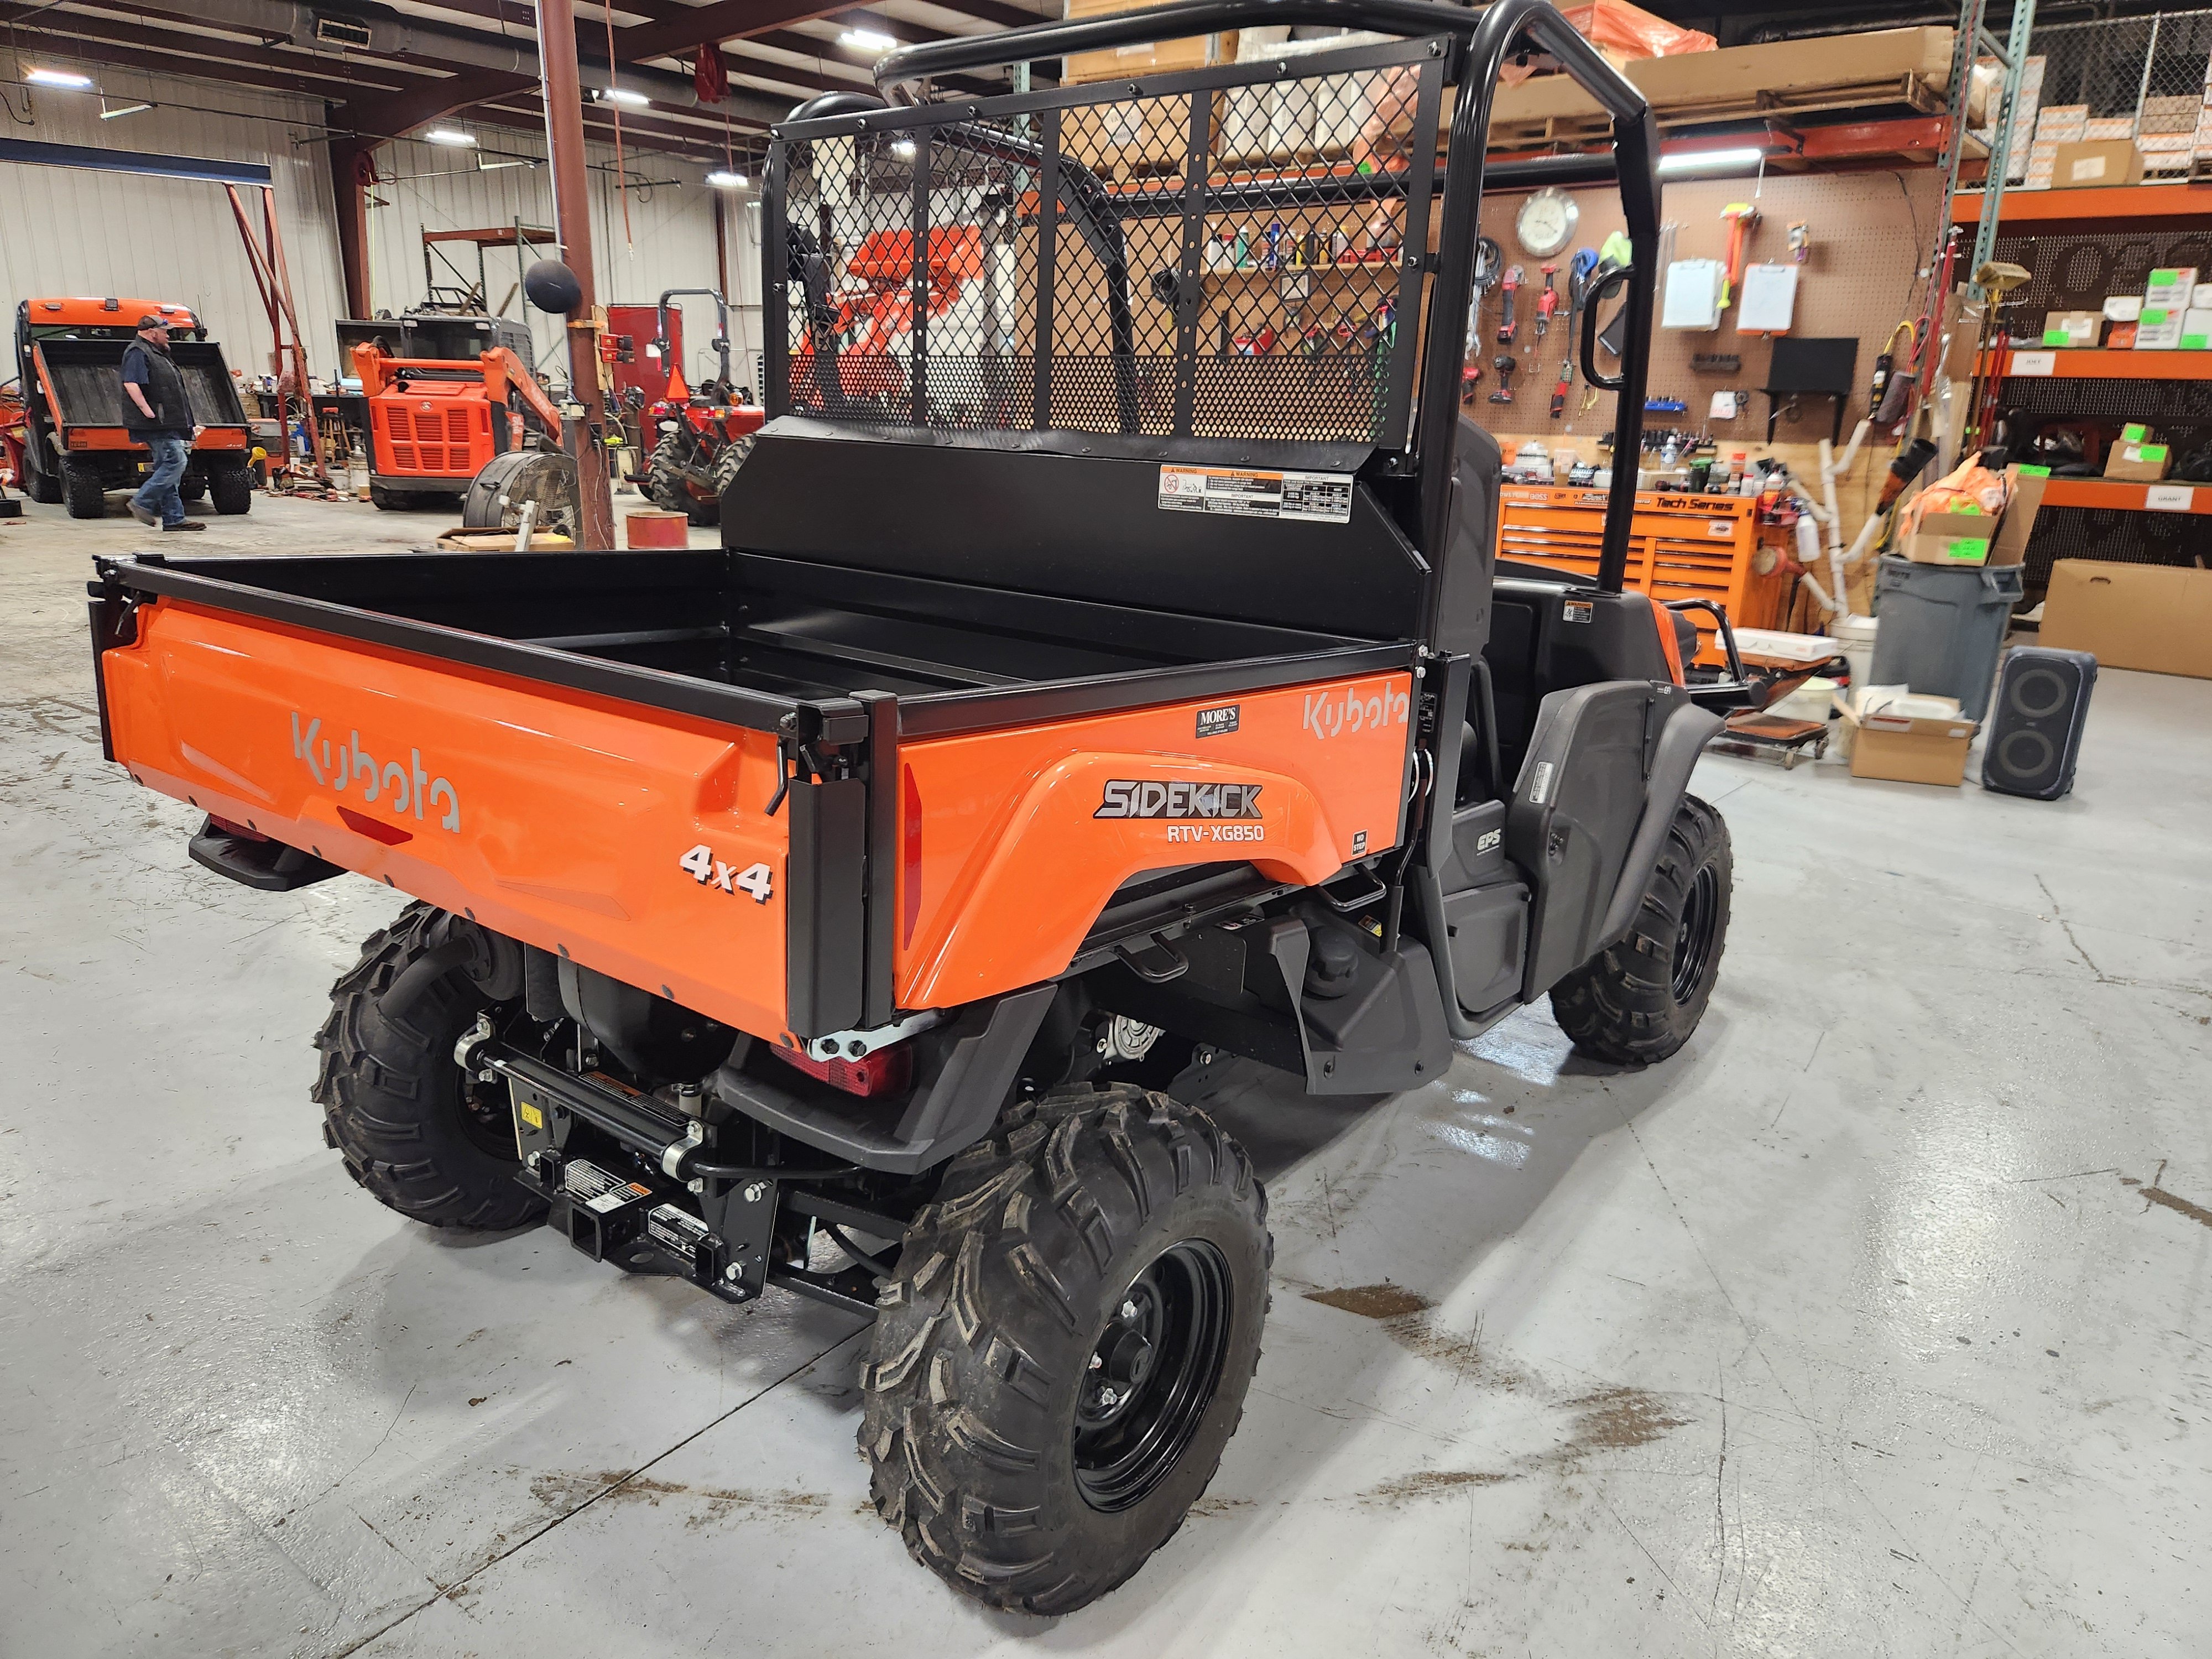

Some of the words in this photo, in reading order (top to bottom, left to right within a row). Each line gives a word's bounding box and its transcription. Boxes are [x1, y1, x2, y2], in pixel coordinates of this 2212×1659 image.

[1657, 497, 1687, 509] Tech
[1688, 499, 1734, 511] Series
[1200, 707, 1236, 726] MORE'S
[1303, 681, 1409, 740] Kubota
[291, 711, 460, 833] Kubota
[1094, 780, 1263, 818] SIDEKICK
[1167, 825, 1264, 842] RTV-XG850
[1357, 834, 1364, 842] NO
[1477, 828, 1501, 851] EPS
[1353, 842, 1365, 852] STEP
[679, 844, 774, 905] 4x4
[677, 1209, 702, 1225] IMPORTANT
